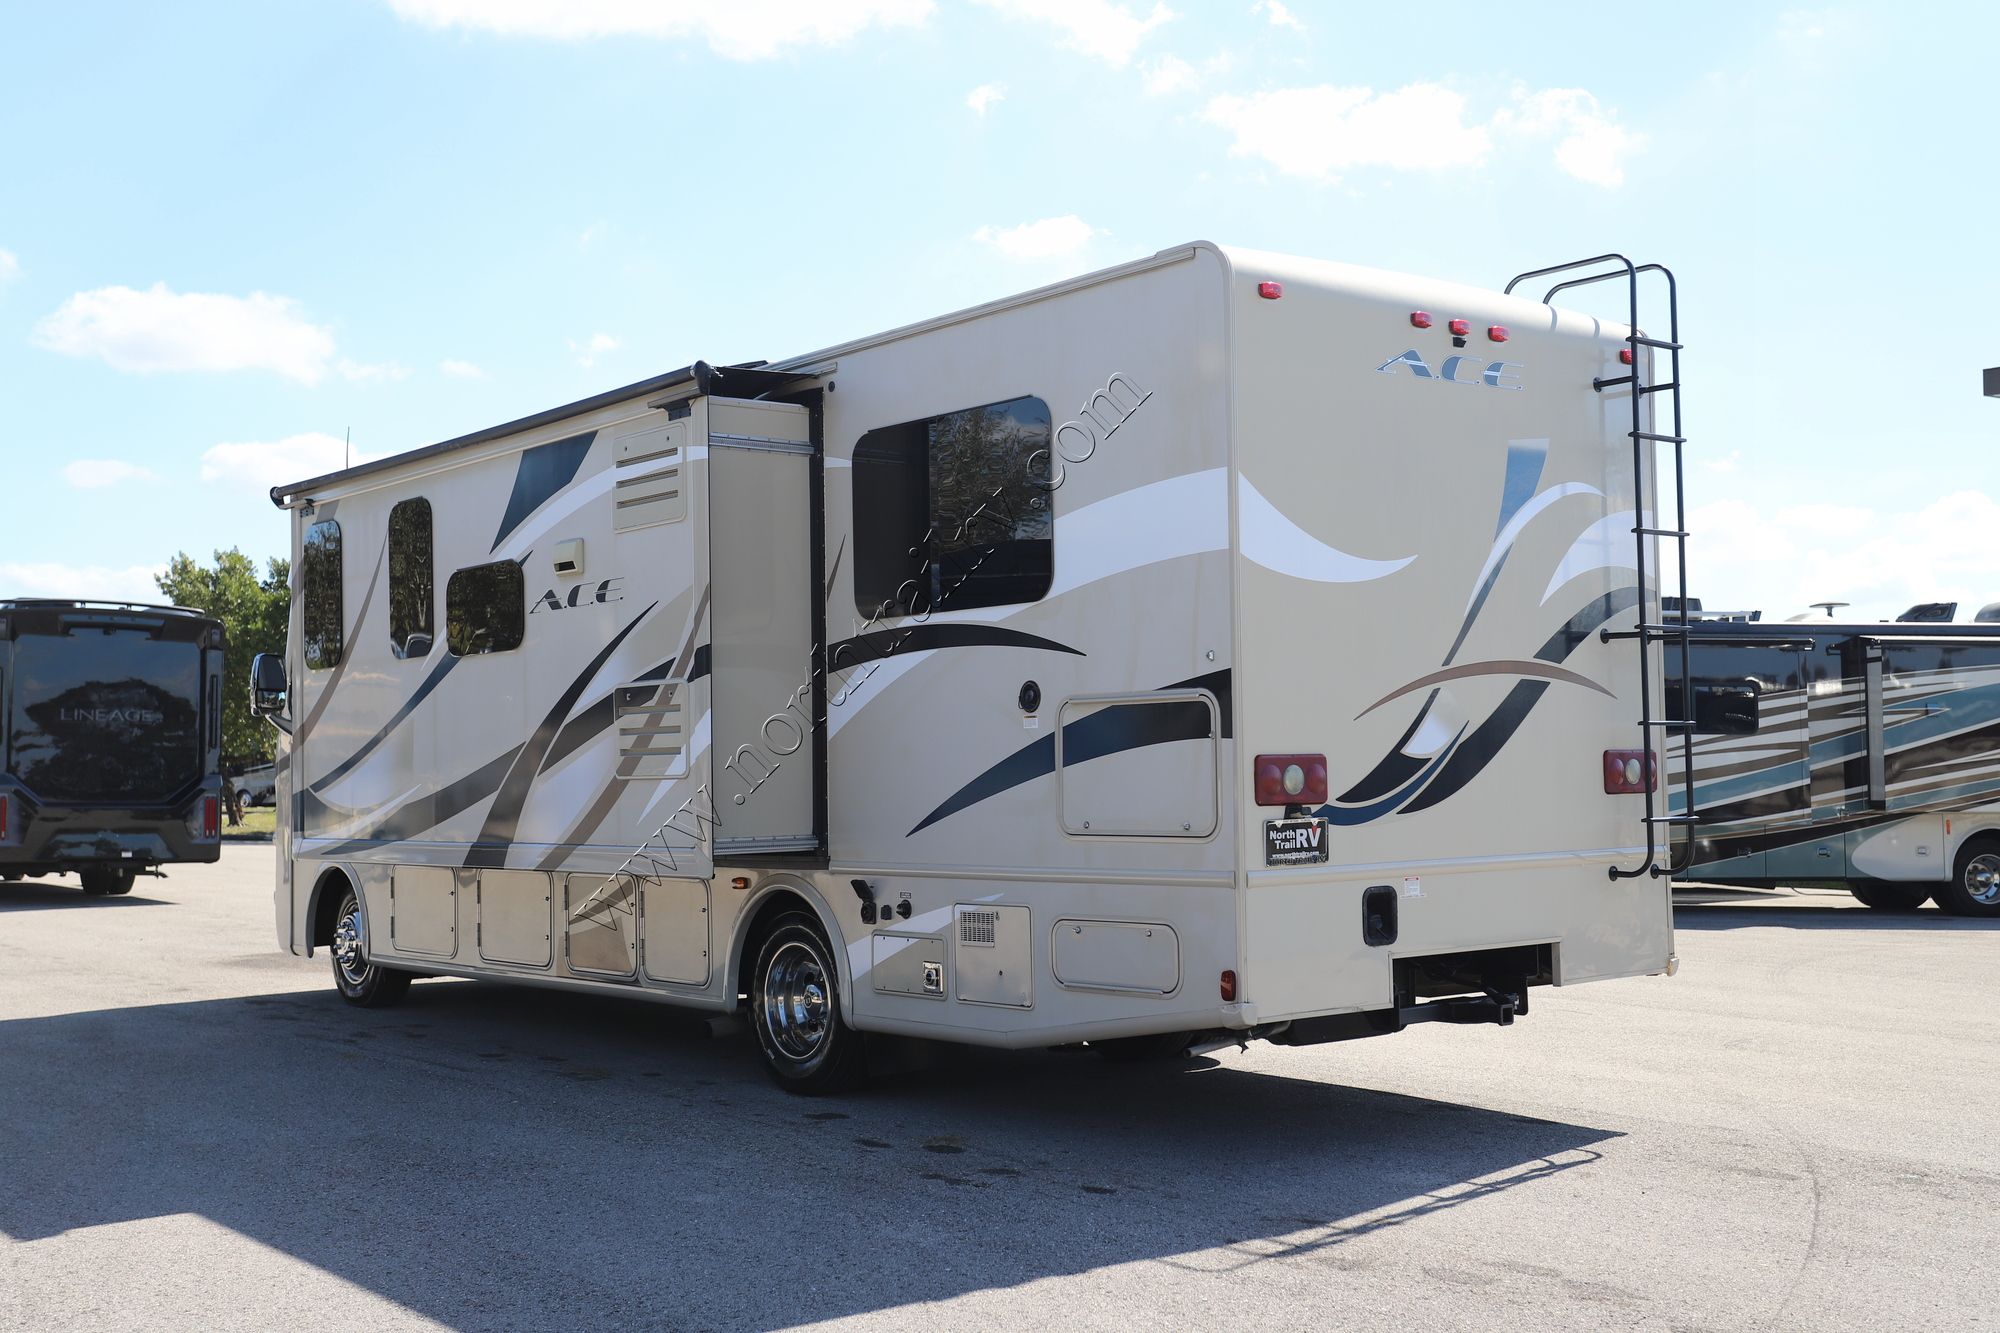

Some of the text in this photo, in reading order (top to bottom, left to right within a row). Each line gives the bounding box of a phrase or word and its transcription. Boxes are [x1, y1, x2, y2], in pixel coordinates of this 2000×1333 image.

[60, 707, 154, 721] LINEAGE
[1269, 830, 1295, 840] North
[1295, 828, 1322, 848] RV
[1274, 840, 1296, 849] Trail
